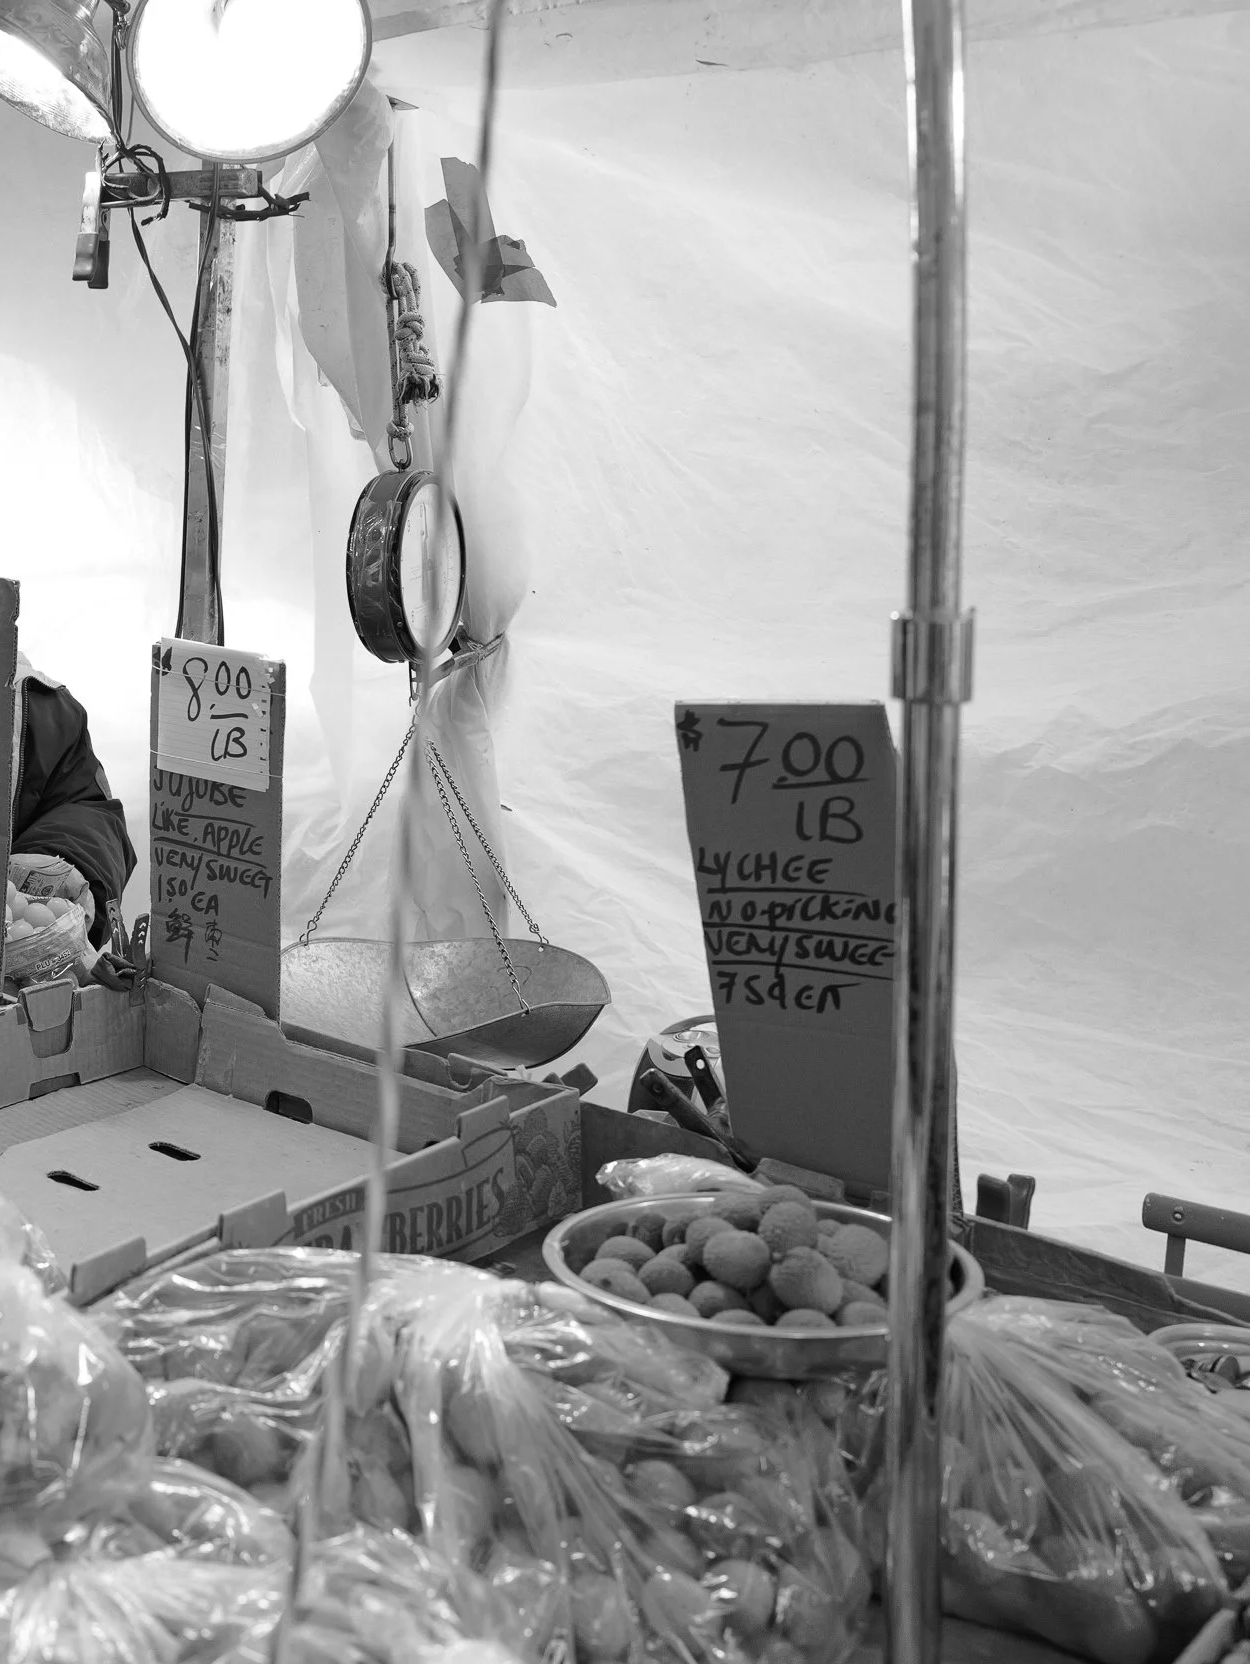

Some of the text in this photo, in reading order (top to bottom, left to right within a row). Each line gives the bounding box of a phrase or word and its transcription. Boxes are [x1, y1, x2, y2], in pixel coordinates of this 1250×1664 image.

[205, 859, 273, 899] SWEET
[698, 847, 833, 893] LYCHEE
[795, 935, 895, 966] SWEE
